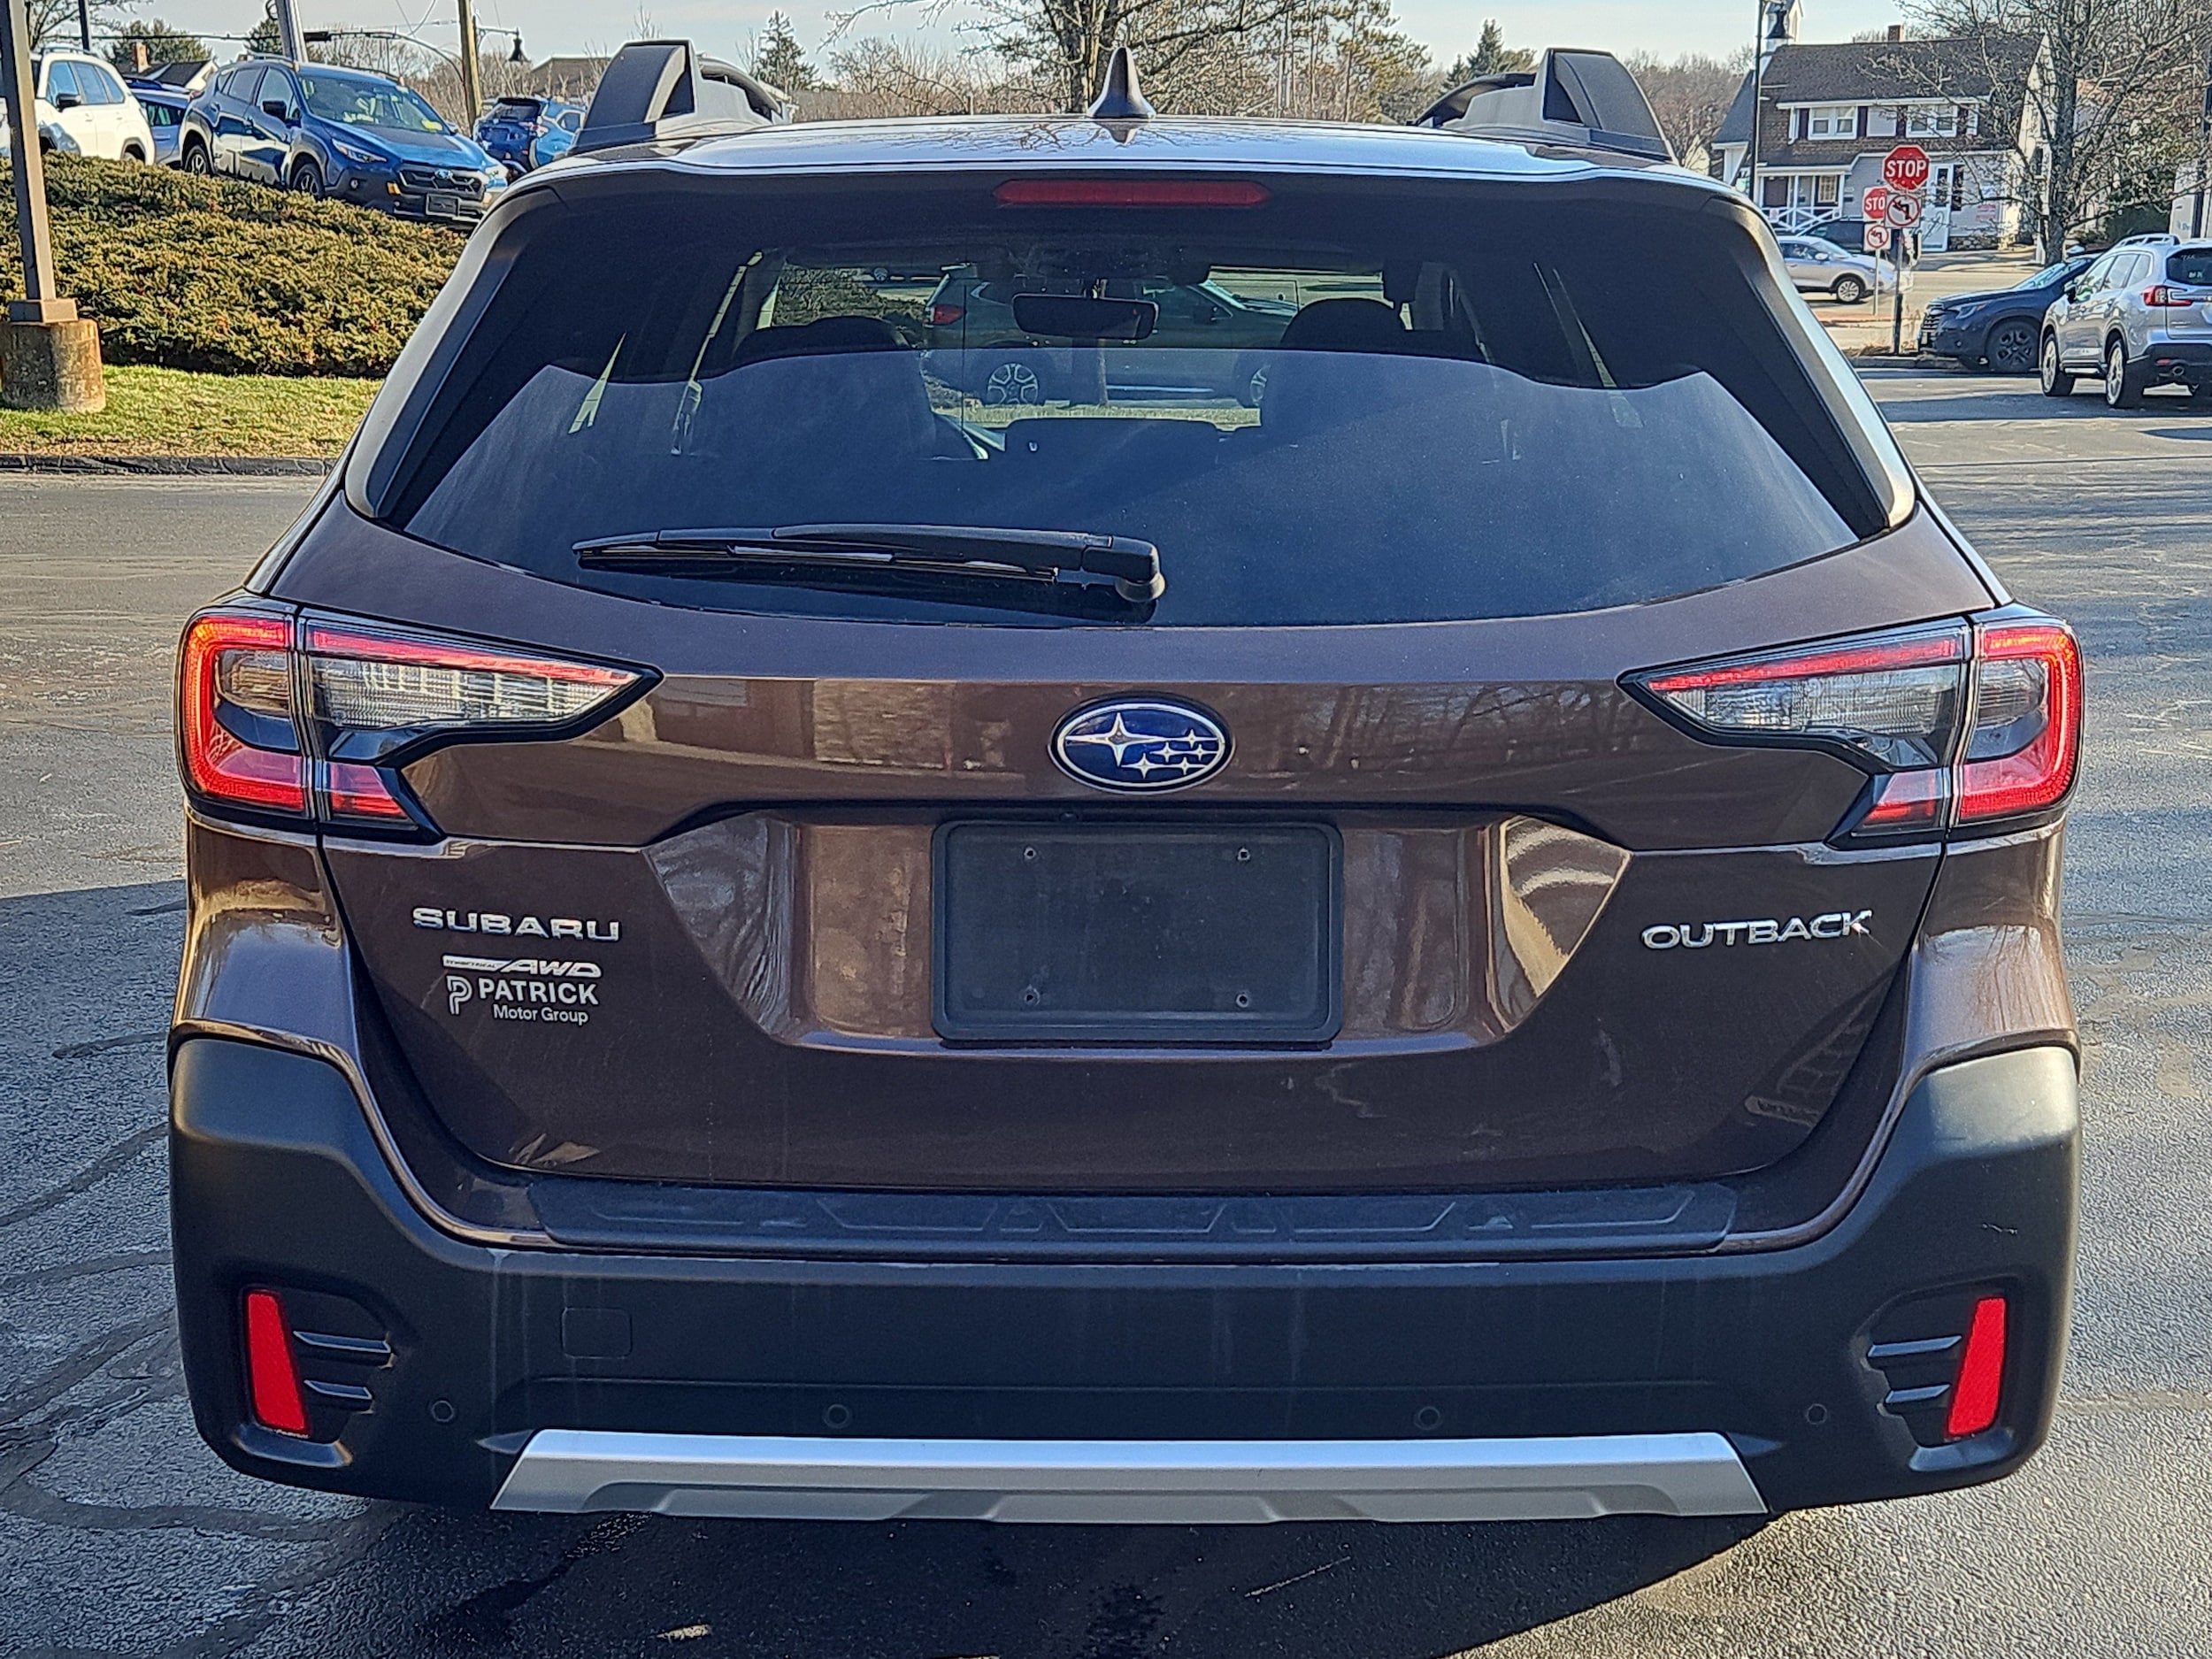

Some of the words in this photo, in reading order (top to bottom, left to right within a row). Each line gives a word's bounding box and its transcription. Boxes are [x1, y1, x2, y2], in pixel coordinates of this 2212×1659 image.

[1886, 160, 1926, 178] STOP
[1865, 196, 1885, 211] STO
[412, 907, 619, 941] SUBARU
[1641, 910, 1872, 949] OUTBACK
[501, 958, 602, 978] AWD
[478, 978, 599, 1005] PATRICK
[493, 1005, 538, 1021] Motor
[541, 1006, 589, 1025] Group
